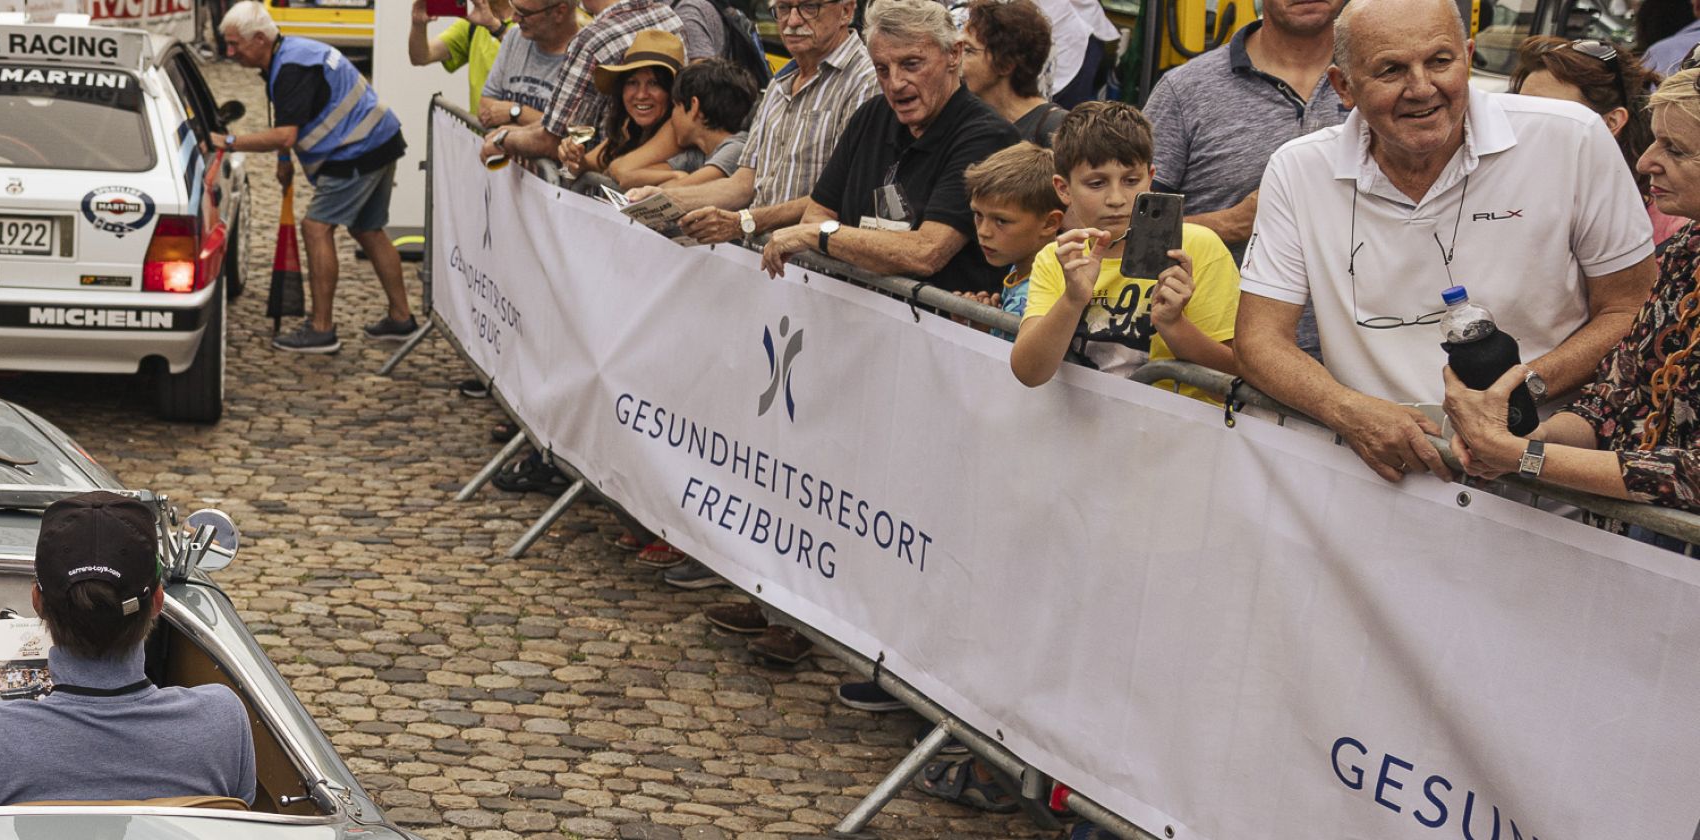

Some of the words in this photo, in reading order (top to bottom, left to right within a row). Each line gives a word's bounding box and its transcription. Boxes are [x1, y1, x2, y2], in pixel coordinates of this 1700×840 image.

[8, 33, 118, 59] RACING
[0, 67, 128, 89] MARTINI
[98, 203, 139, 211] MARTINI
[1472, 209, 1523, 222] RLX
[29, 306, 173, 330] MICHELIN
[615, 393, 933, 573] GESUNDHEITSRESORT
[681, 477, 837, 579] FREIBURG
